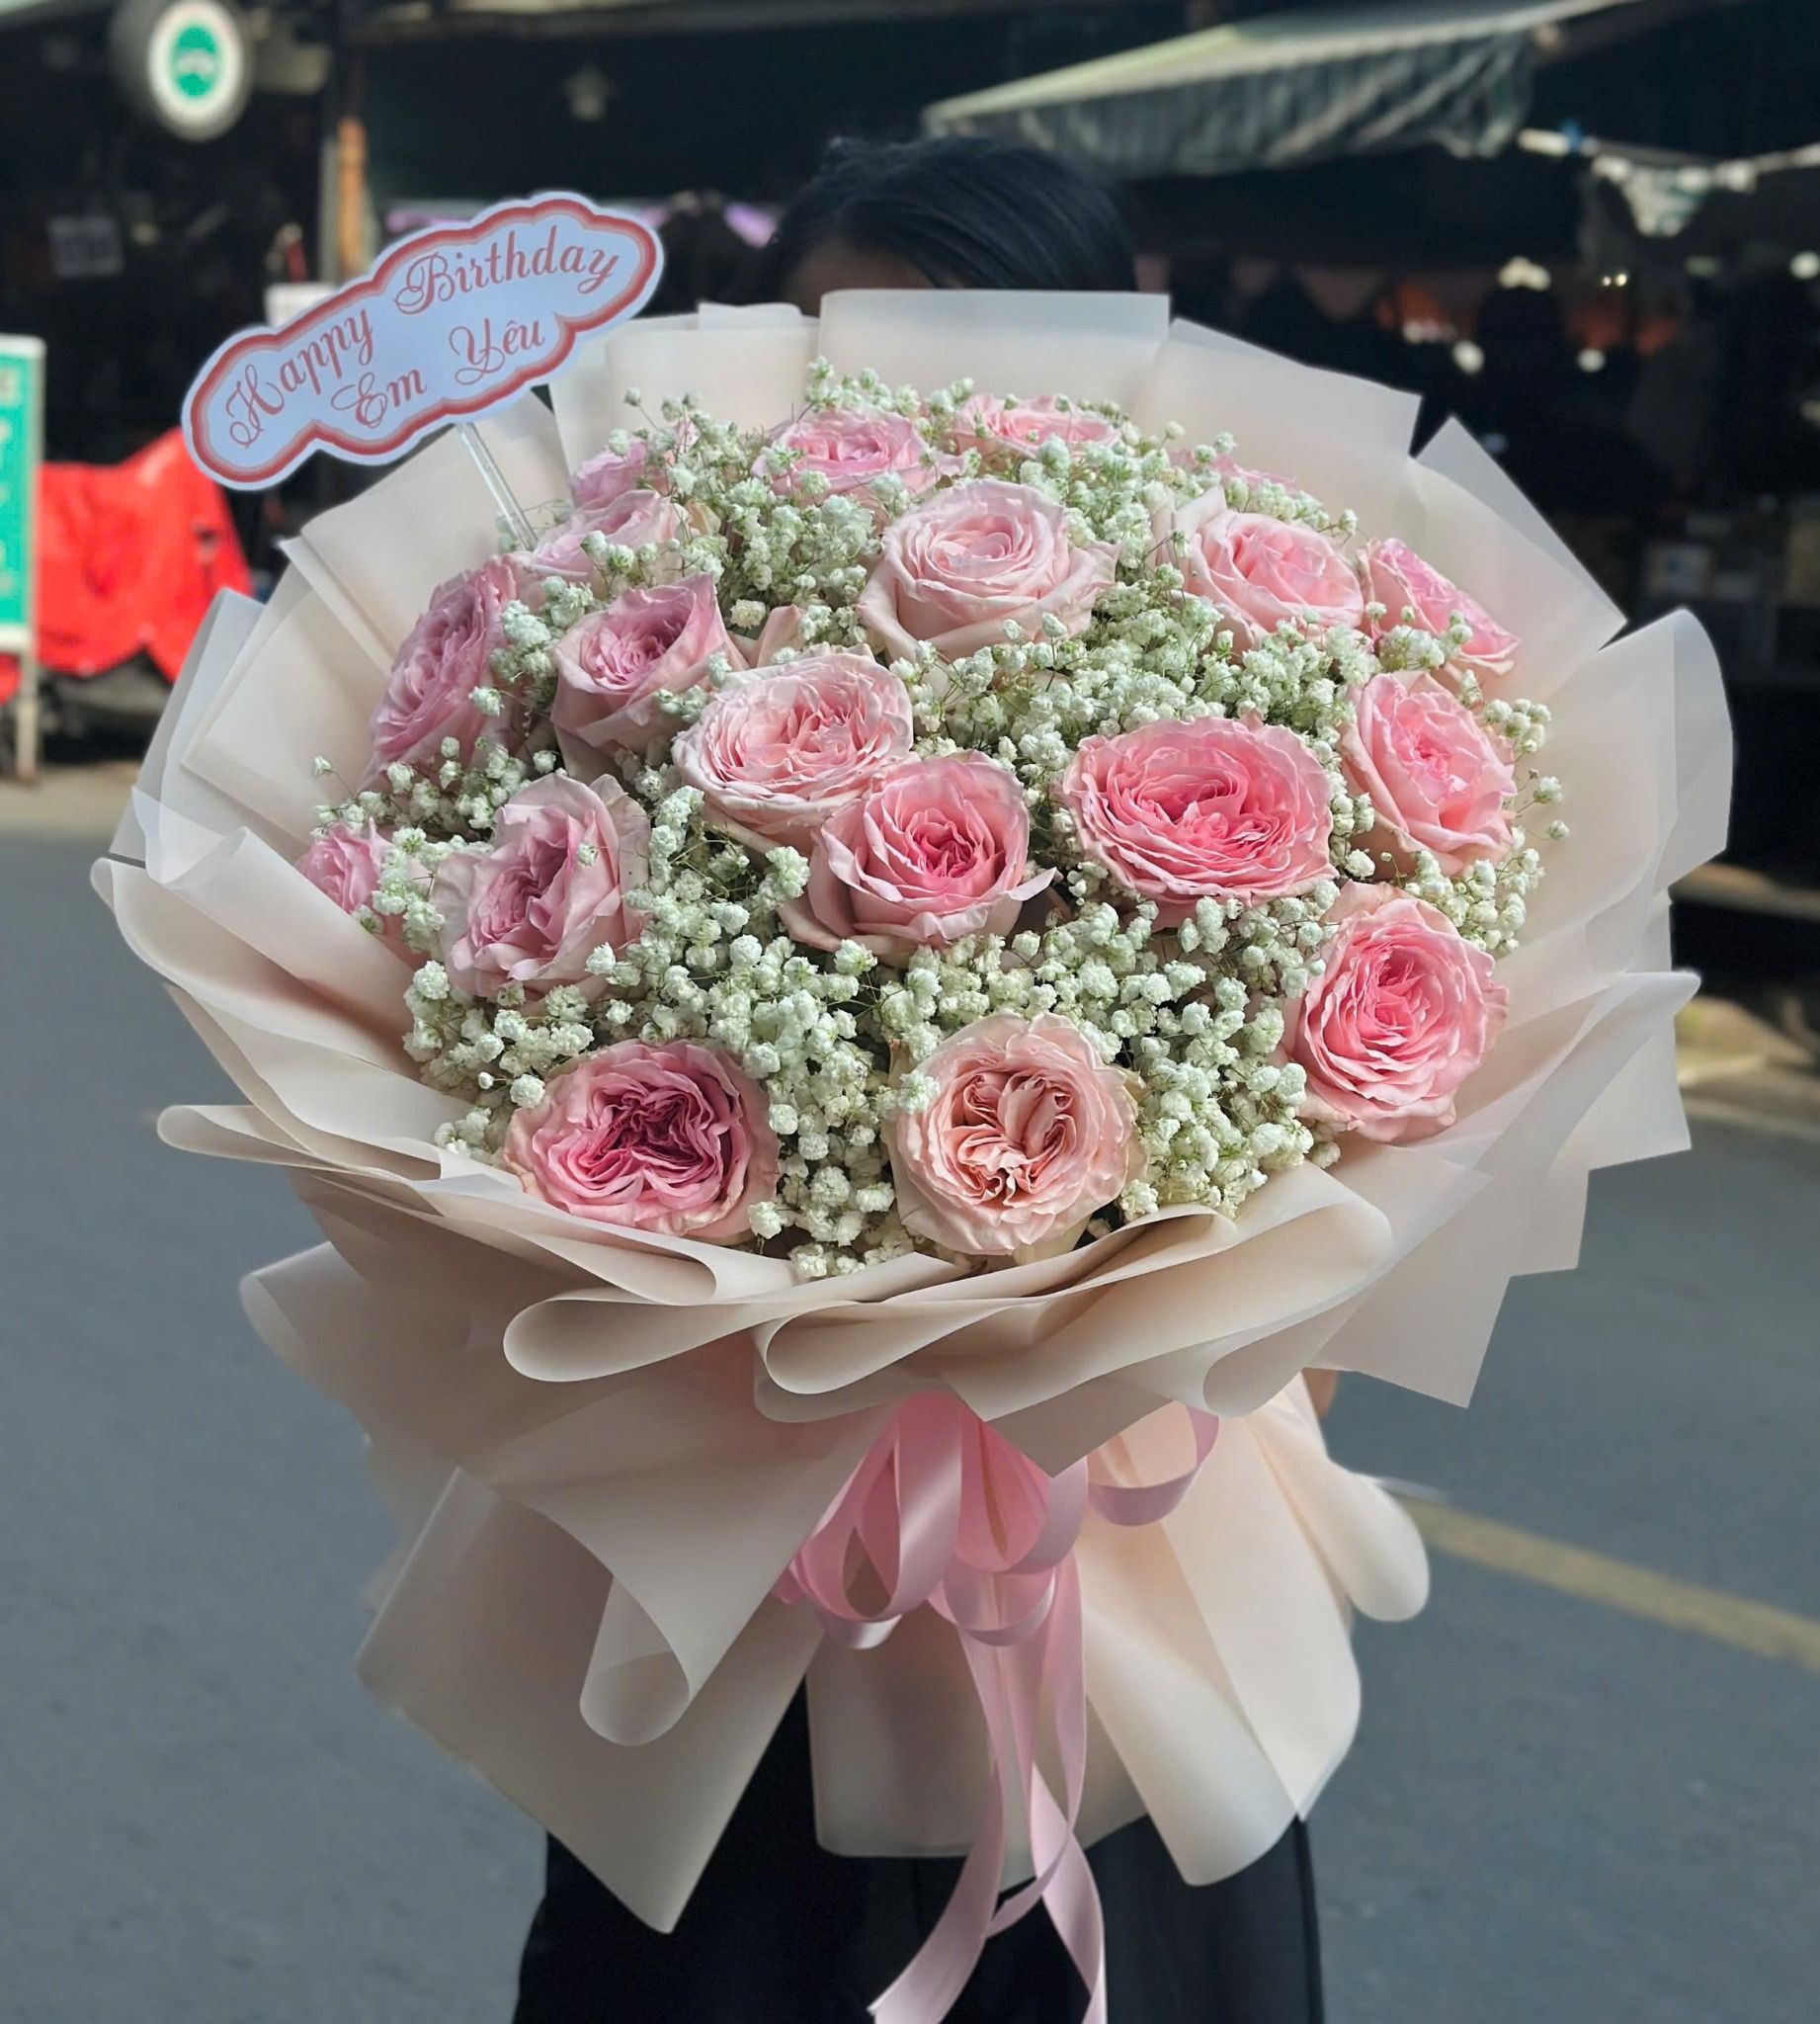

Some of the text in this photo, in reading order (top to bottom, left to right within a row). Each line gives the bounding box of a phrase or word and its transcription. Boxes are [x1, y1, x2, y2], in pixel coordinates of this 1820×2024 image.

[225, 225, 620, 449] Happy Birthday
[331, 317, 545, 429] Em Yêu
